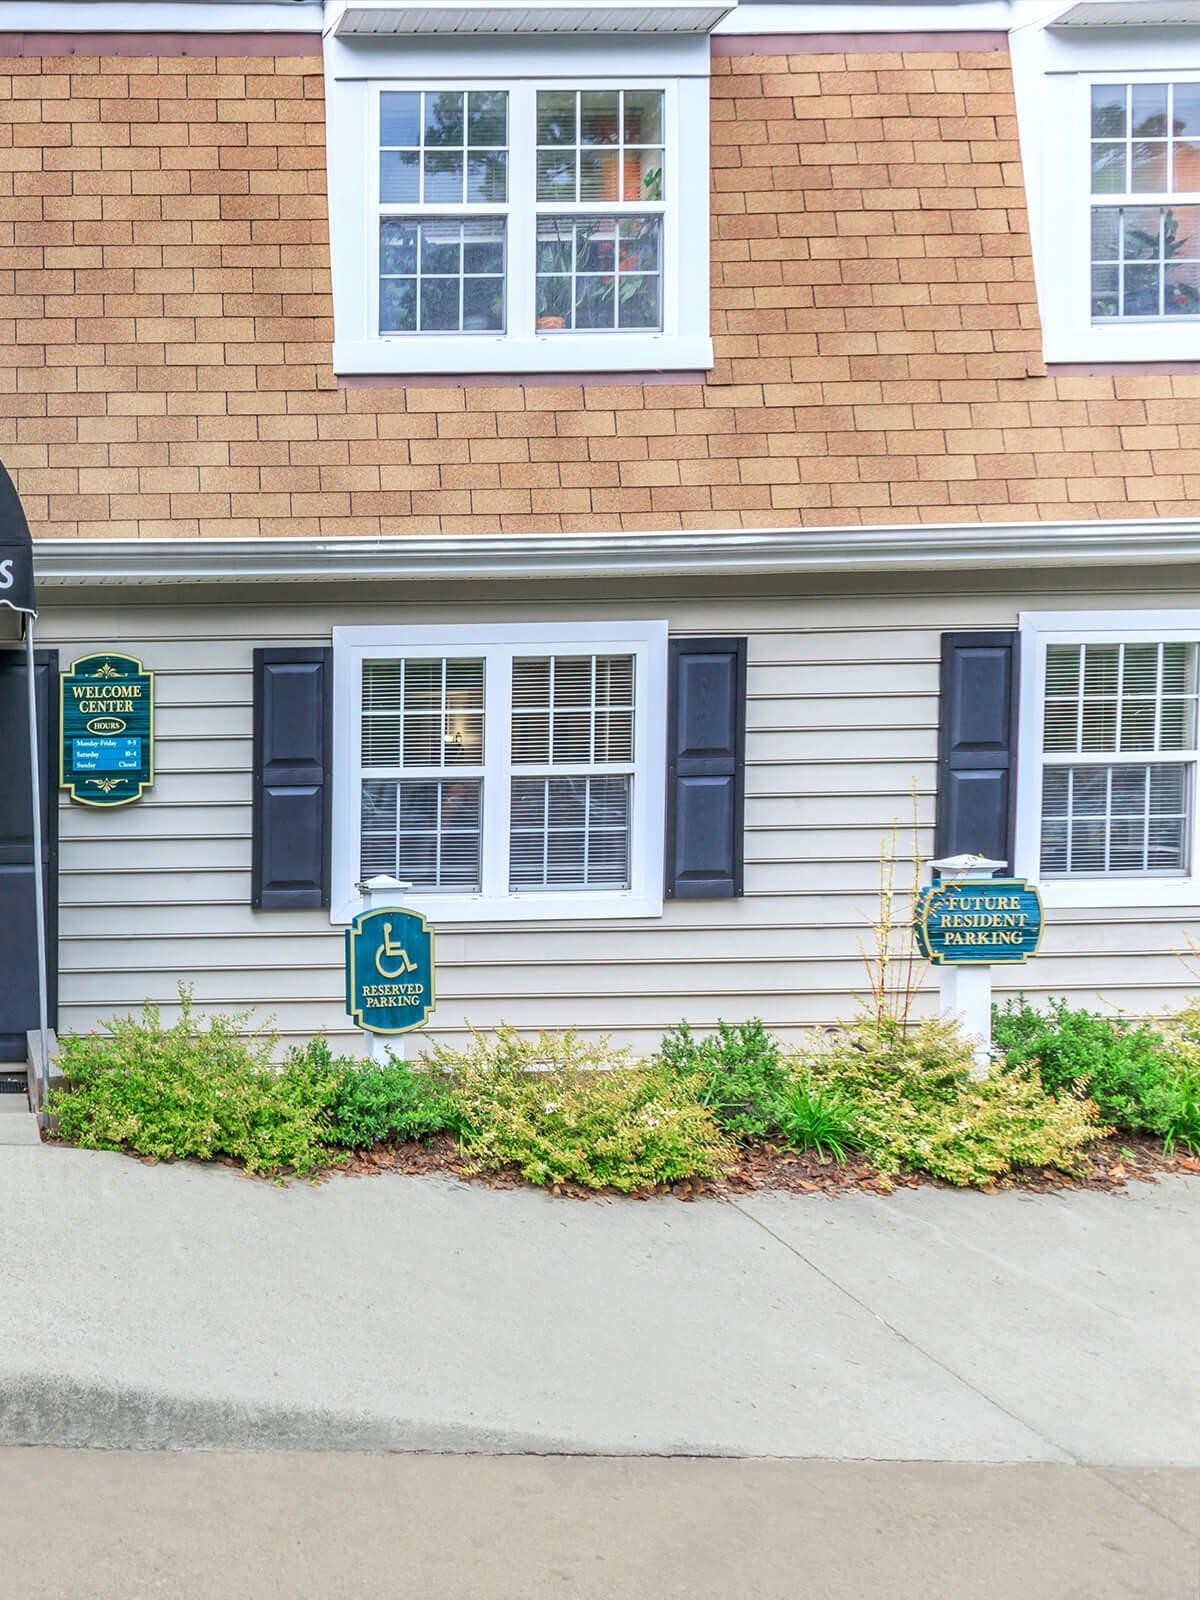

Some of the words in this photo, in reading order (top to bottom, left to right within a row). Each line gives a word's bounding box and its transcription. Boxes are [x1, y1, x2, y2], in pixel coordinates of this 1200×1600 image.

[72, 685, 142, 699] WELCOME
[79, 700, 134, 713] CENTER
[93, 721, 120, 730] HOURS
[76, 751, 100, 759] Saturday
[76, 761, 97, 769] Sunday
[118, 760, 137, 768] Closed
[947, 896, 1020, 911] FUTURE
[940, 913, 1029, 928] RESIDENT
[943, 931, 1023, 946] PARKING
[362, 983, 425, 997] RESERVED
[366, 995, 420, 1008] PARKING
